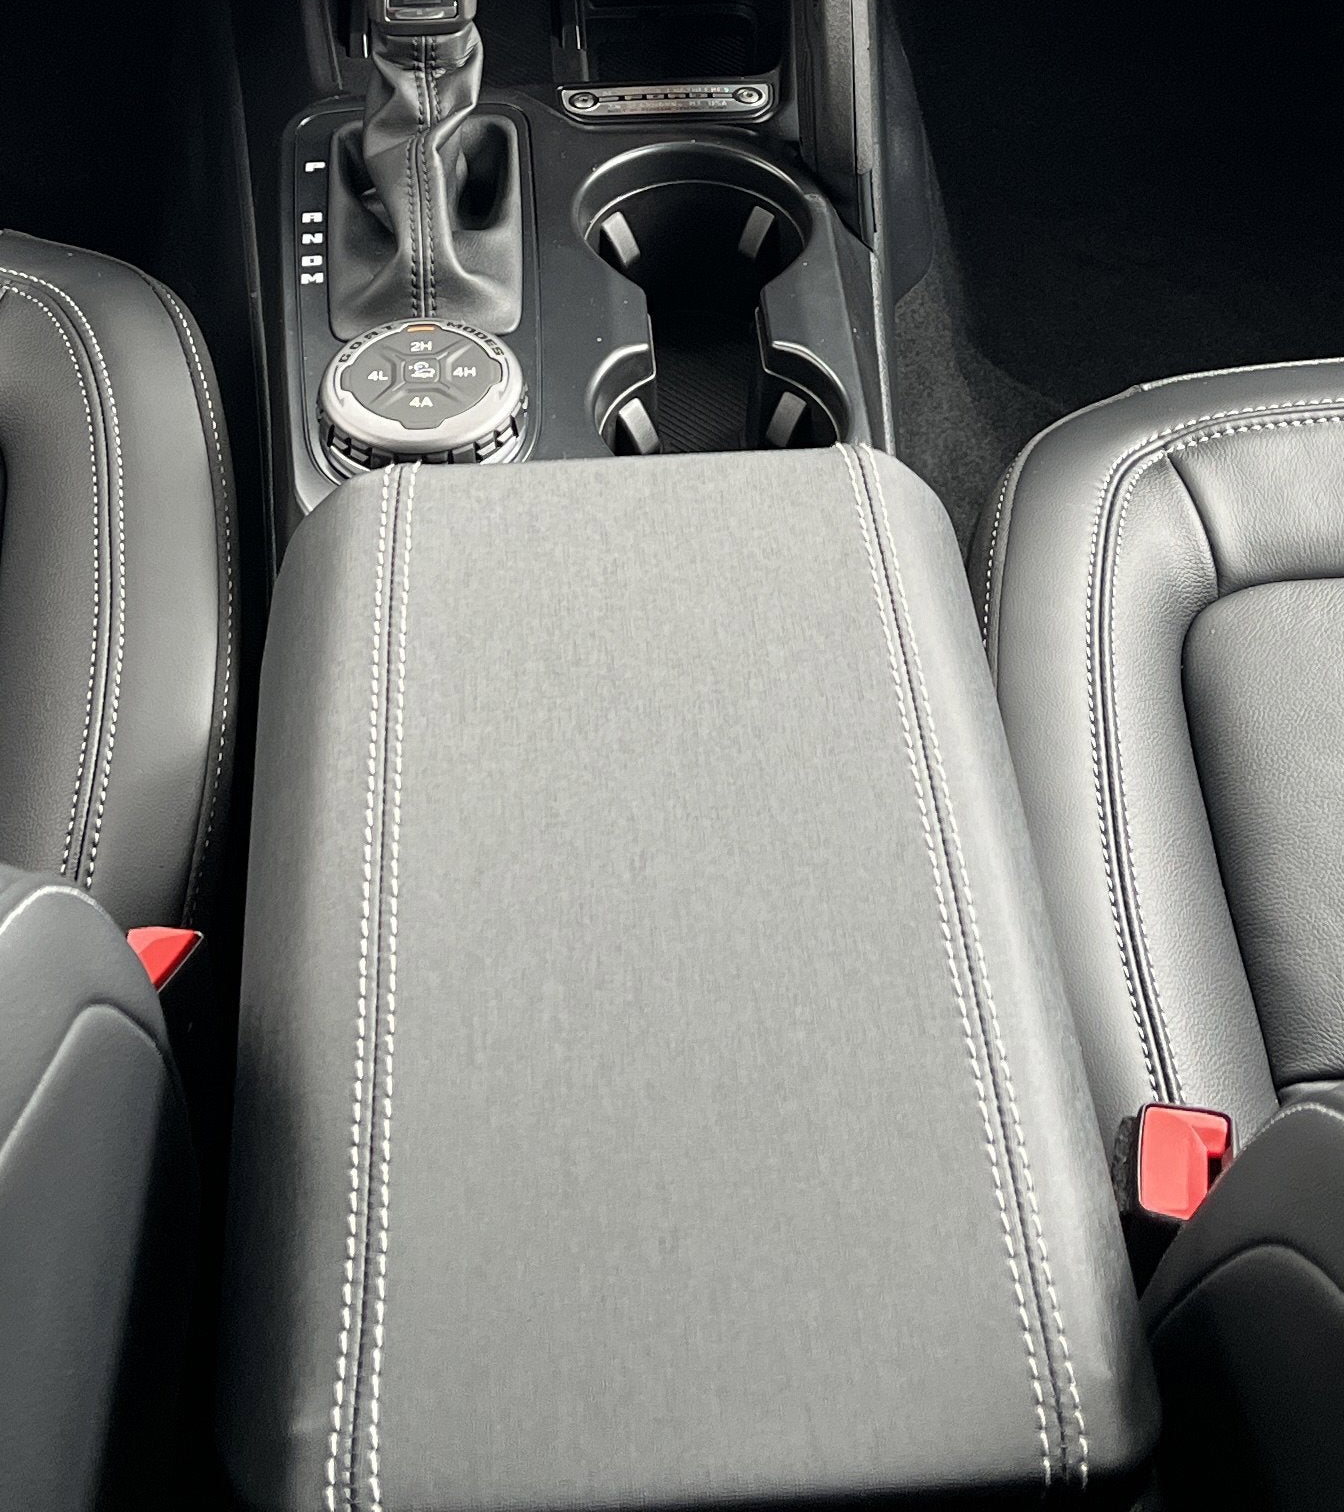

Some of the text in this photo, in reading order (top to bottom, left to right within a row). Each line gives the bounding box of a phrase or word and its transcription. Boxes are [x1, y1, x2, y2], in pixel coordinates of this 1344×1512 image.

[304, 161, 326, 172] P
[301, 233, 323, 244] N
[301, 255, 323, 266] D
[300, 272, 324, 285] M
[446, 321, 505, 357] MODES
[410, 341, 432, 352] 2H
[367, 369, 388, 381] 4L
[452, 366, 476, 378] 4H
[409, 396, 433, 407] 4A
